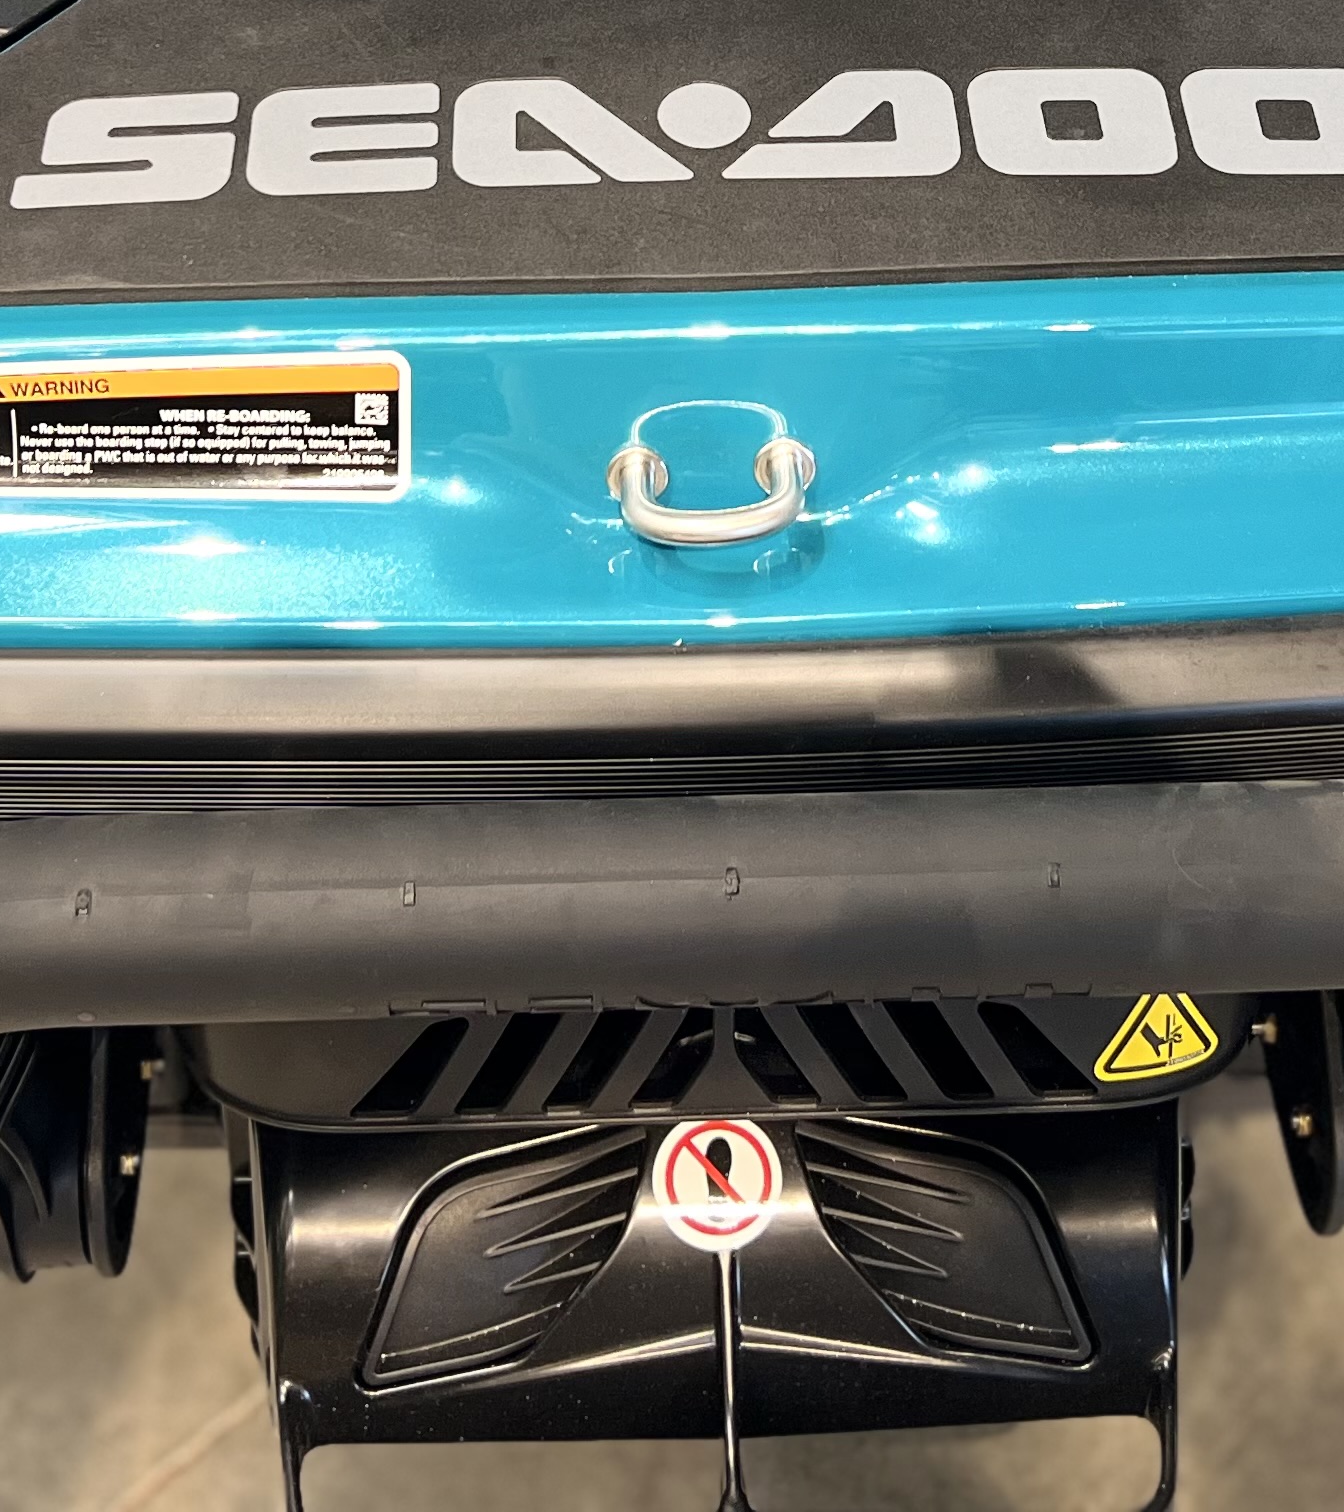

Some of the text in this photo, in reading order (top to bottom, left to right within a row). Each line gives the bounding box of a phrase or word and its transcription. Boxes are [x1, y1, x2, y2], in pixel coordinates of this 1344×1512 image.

[10, 378, 110, 397] WARNING
[159, 409, 311, 424] WHEN RE-BOARDING:
[39, 423, 376, 438] Re-board one person at a time. Stay centered to keep balance.
[20, 435, 54, 448] Never
[54, 437, 75, 448] use
[75, 436, 94, 448] the
[95, 436, 143, 450] boarding
[144, 437, 168, 450] step
[169, 436, 182, 449] (if
[182, 438, 196, 448] so
[197, 436, 251, 451] equipped)
[251, 436, 268, 449] for
[348, 437, 391, 453] jumping
[21, 451, 35, 461] or
[35, 449, 83, 464] boarding
[94, 450, 121, 464] PWC
[122, 450, 144, 463] that
[145, 450, 156, 463] is
[156, 452, 175, 464] out
[176, 450, 188, 464] of
[189, 452, 221, 464] water
[235, 453, 256, 466] any
[256, 453, 301, 466] purpose
[22, 463, 41, 474] not
